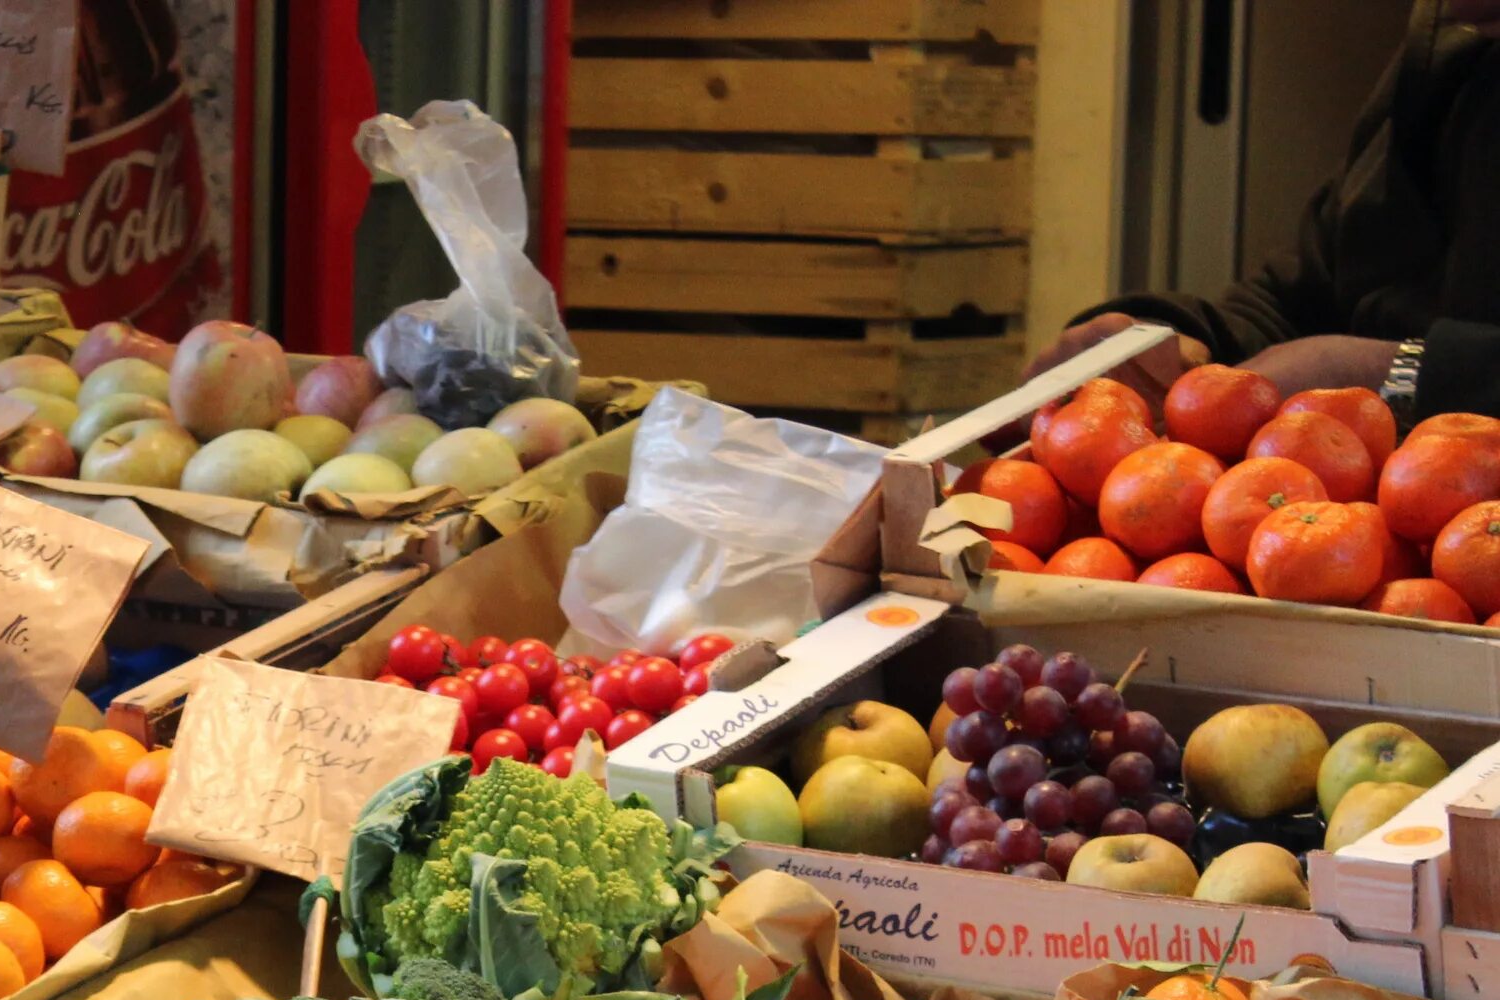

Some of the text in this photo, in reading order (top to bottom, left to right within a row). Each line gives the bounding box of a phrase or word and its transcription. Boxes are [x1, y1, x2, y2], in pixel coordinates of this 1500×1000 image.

[648, 694, 779, 763] Depaoli
[846, 867, 920, 893] Agricola
[958, 922, 1033, 957] D.O.P.
[1043, 921, 1110, 961] mela
[1114, 922, 1160, 962] Val
[1166, 923, 1193, 963] di
